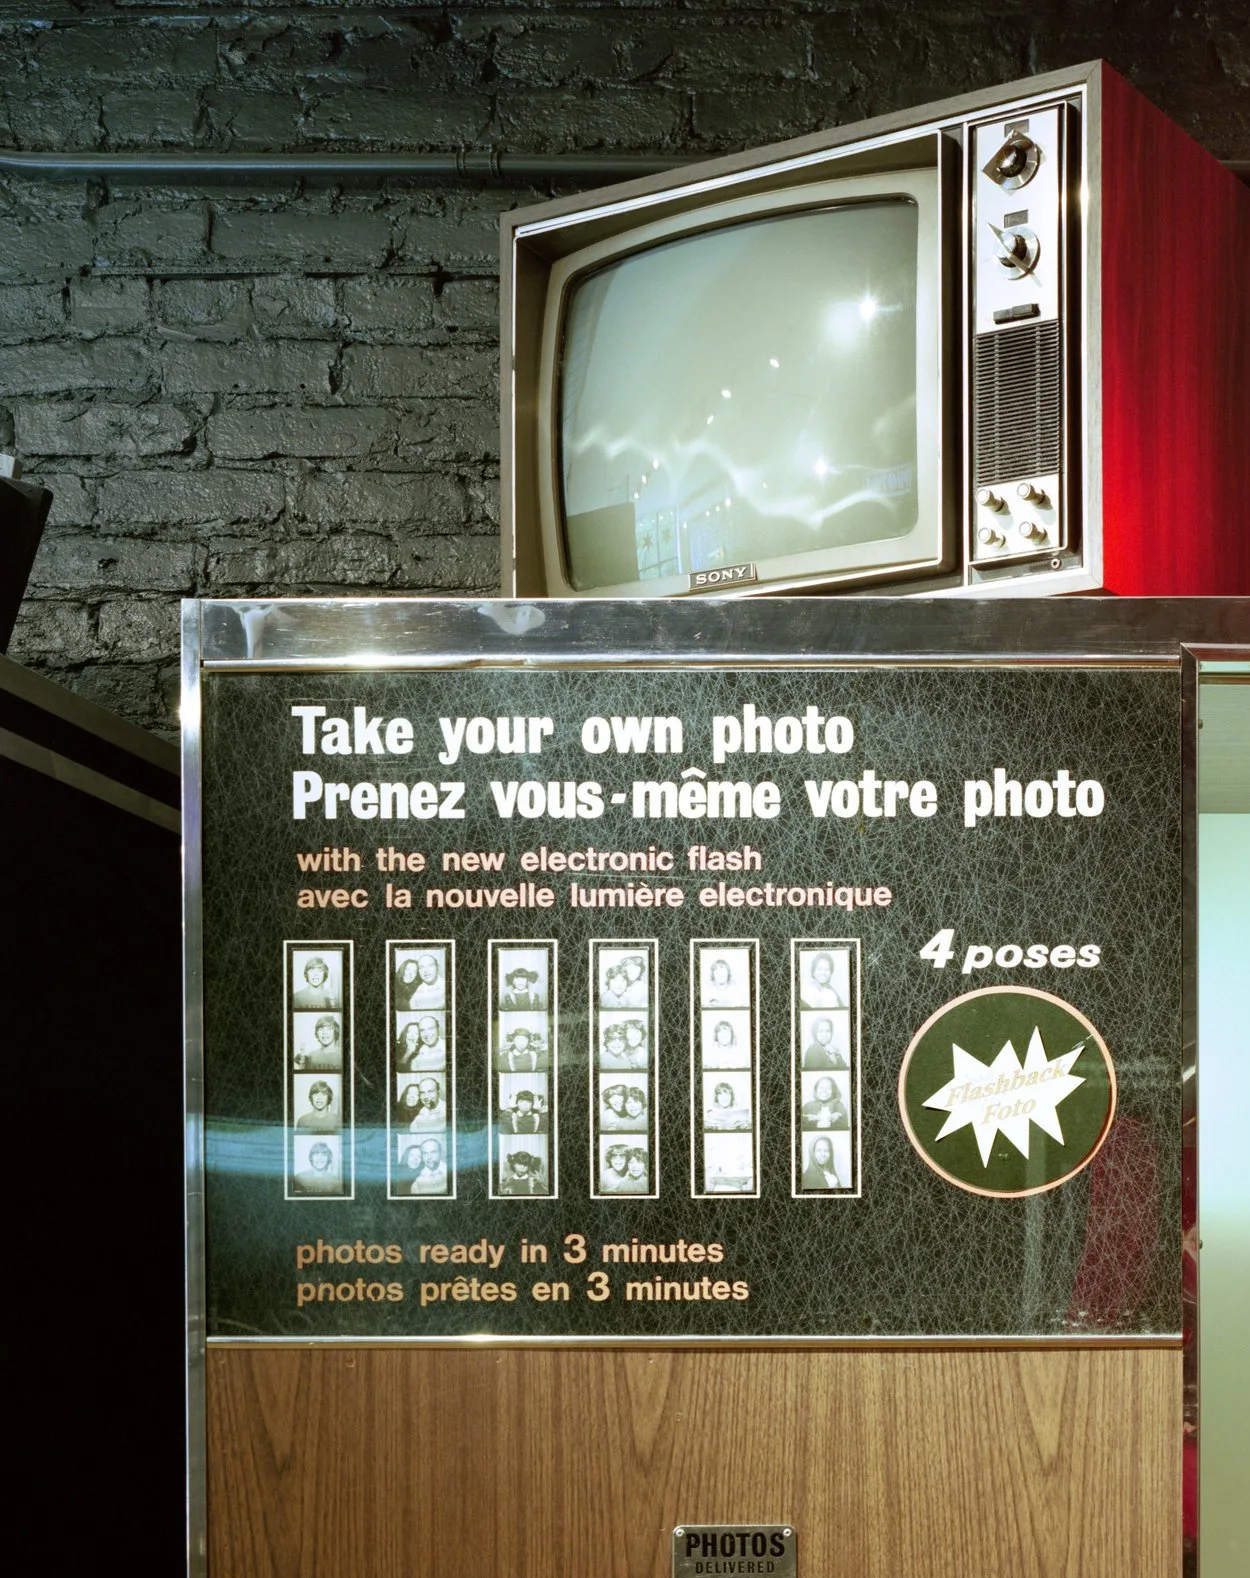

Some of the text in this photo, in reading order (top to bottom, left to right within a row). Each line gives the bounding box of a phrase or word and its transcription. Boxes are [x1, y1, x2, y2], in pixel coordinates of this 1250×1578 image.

[695, 566, 747, 585] SONY
[291, 703, 855, 766] Take your own photo
[292, 766, 1106, 828] Prenez vous-même votre photo
[296, 845, 762, 872] with the new electronic flash
[296, 881, 893, 912] avec la nouvelle lumière electronique
[919, 928, 1101, 975] 4 poses
[944, 1058, 1068, 1109] Flashback
[981, 1098, 1037, 1126] Foto
[296, 1233, 725, 1269] photos ready in 3 minutes
[420, 1275, 518, 1307] prêtes
[531, 1280, 571, 1302] en
[586, 1271, 611, 1302] 3
[625, 1275, 750, 1302] minutes
[685, 1532, 786, 1558] PHOTOS
[695, 1561, 775, 1574] DELIVERED
